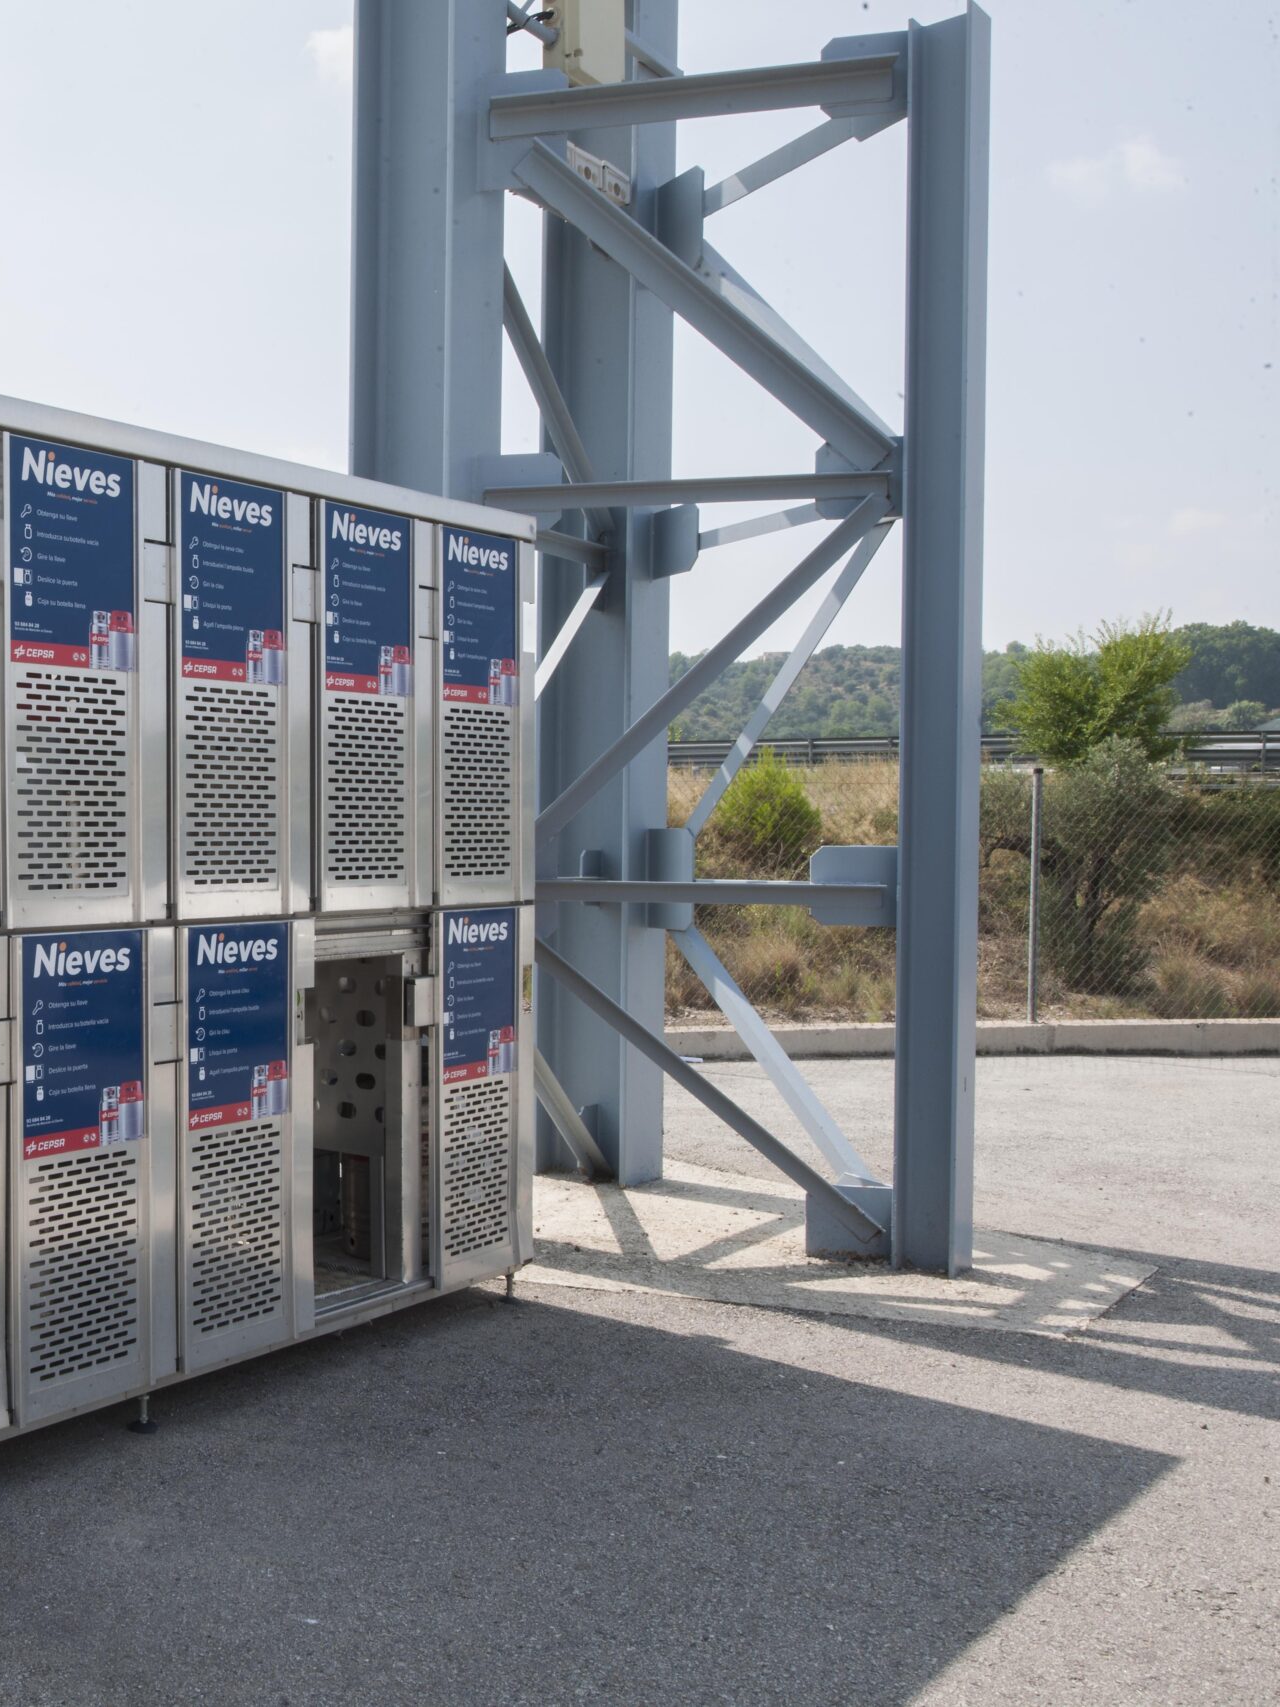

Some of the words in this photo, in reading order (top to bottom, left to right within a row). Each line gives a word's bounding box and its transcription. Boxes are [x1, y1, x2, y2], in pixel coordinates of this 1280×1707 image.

[21, 446, 120, 497] Nieves
[190, 481, 272, 526] Nieves
[332, 510, 401, 551] Nieves
[448, 534, 508, 570] Nieves
[26, 648, 54, 658] CEPSA
[194, 665, 217, 673] CEPSA
[448, 917, 508, 944] Nieves
[33, 942, 130, 978] Nieves
[197, 933, 278, 965] Nieves
[200, 1112, 222, 1122] CEPSA
[38, 1139, 65, 1151] CEPSA
